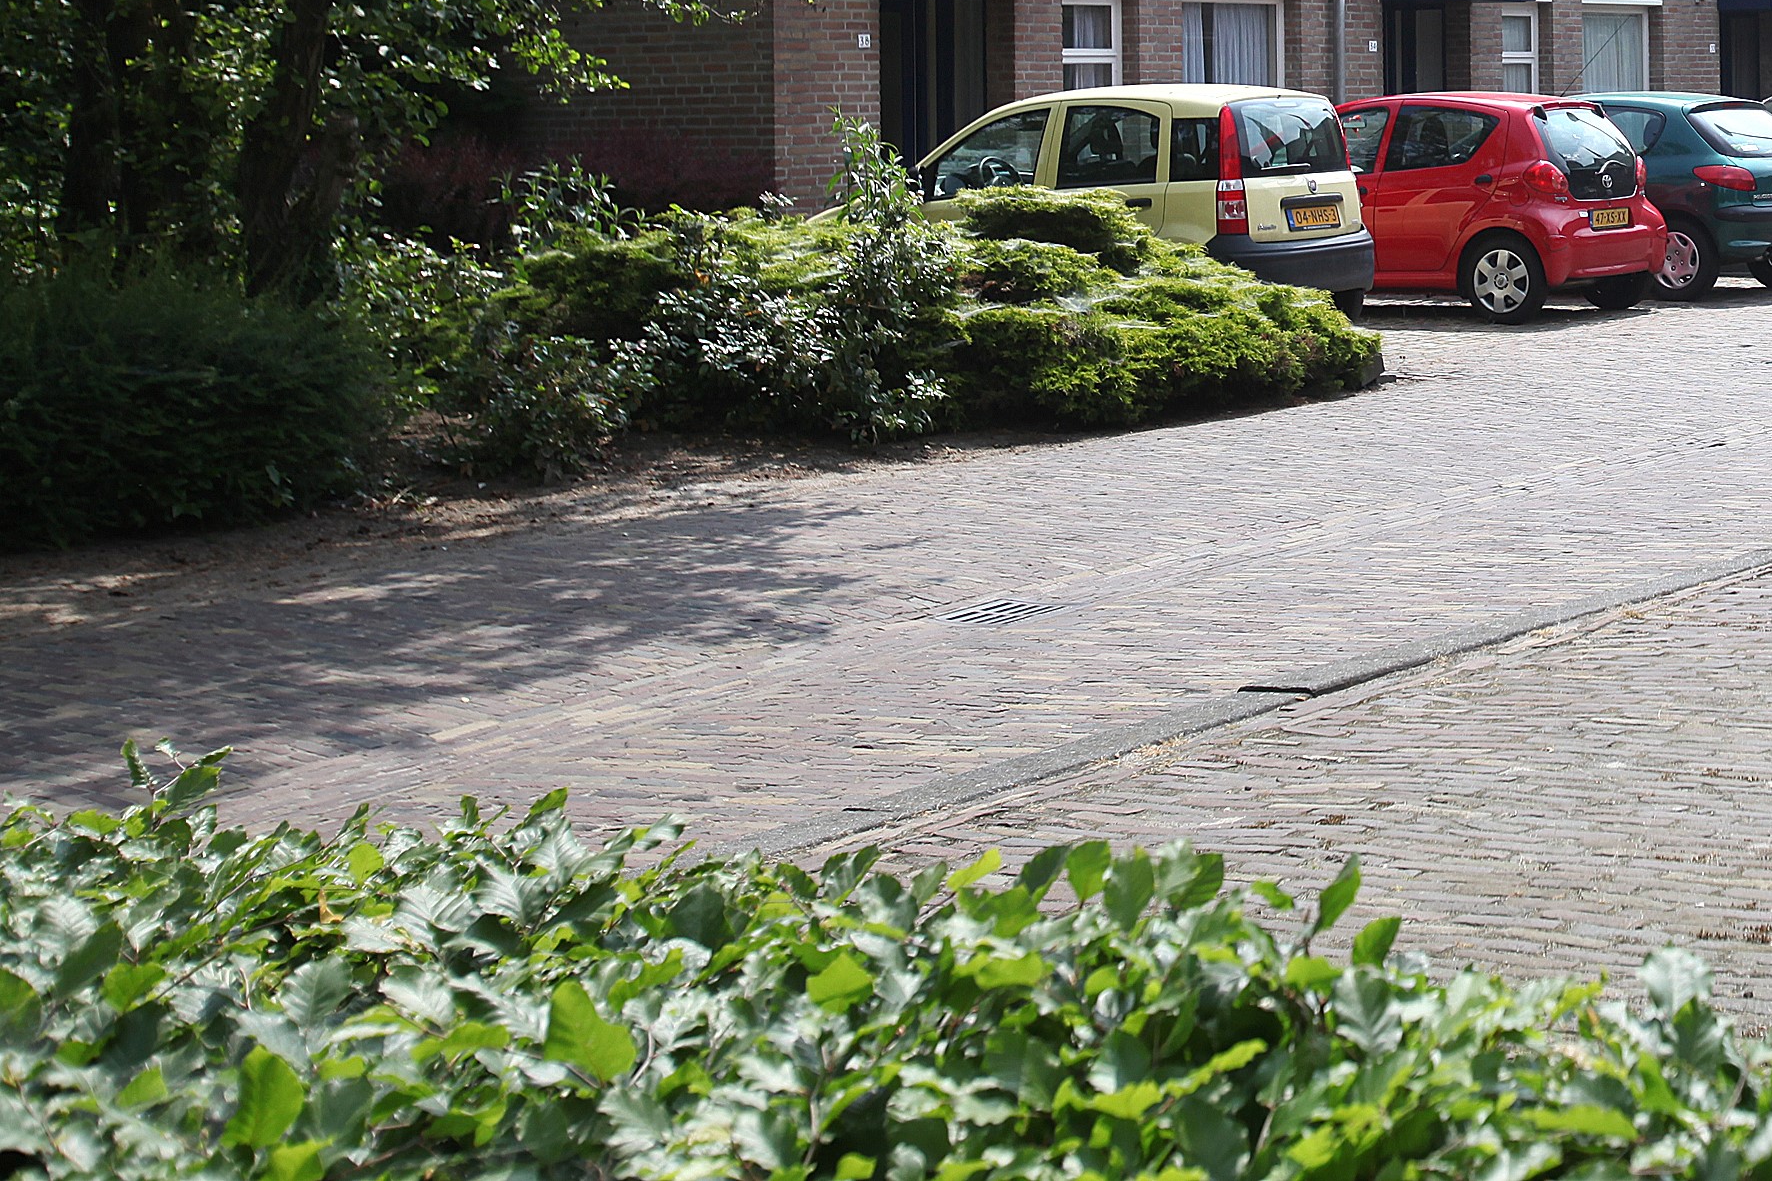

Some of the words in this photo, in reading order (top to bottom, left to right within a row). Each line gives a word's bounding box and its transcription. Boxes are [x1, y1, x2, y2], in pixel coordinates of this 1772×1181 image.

[859, 35, 870, 47] 38
[1295, 208, 1337, 224] 04-NHS-3
[1595, 210, 1626, 225] 47-XS-XX
